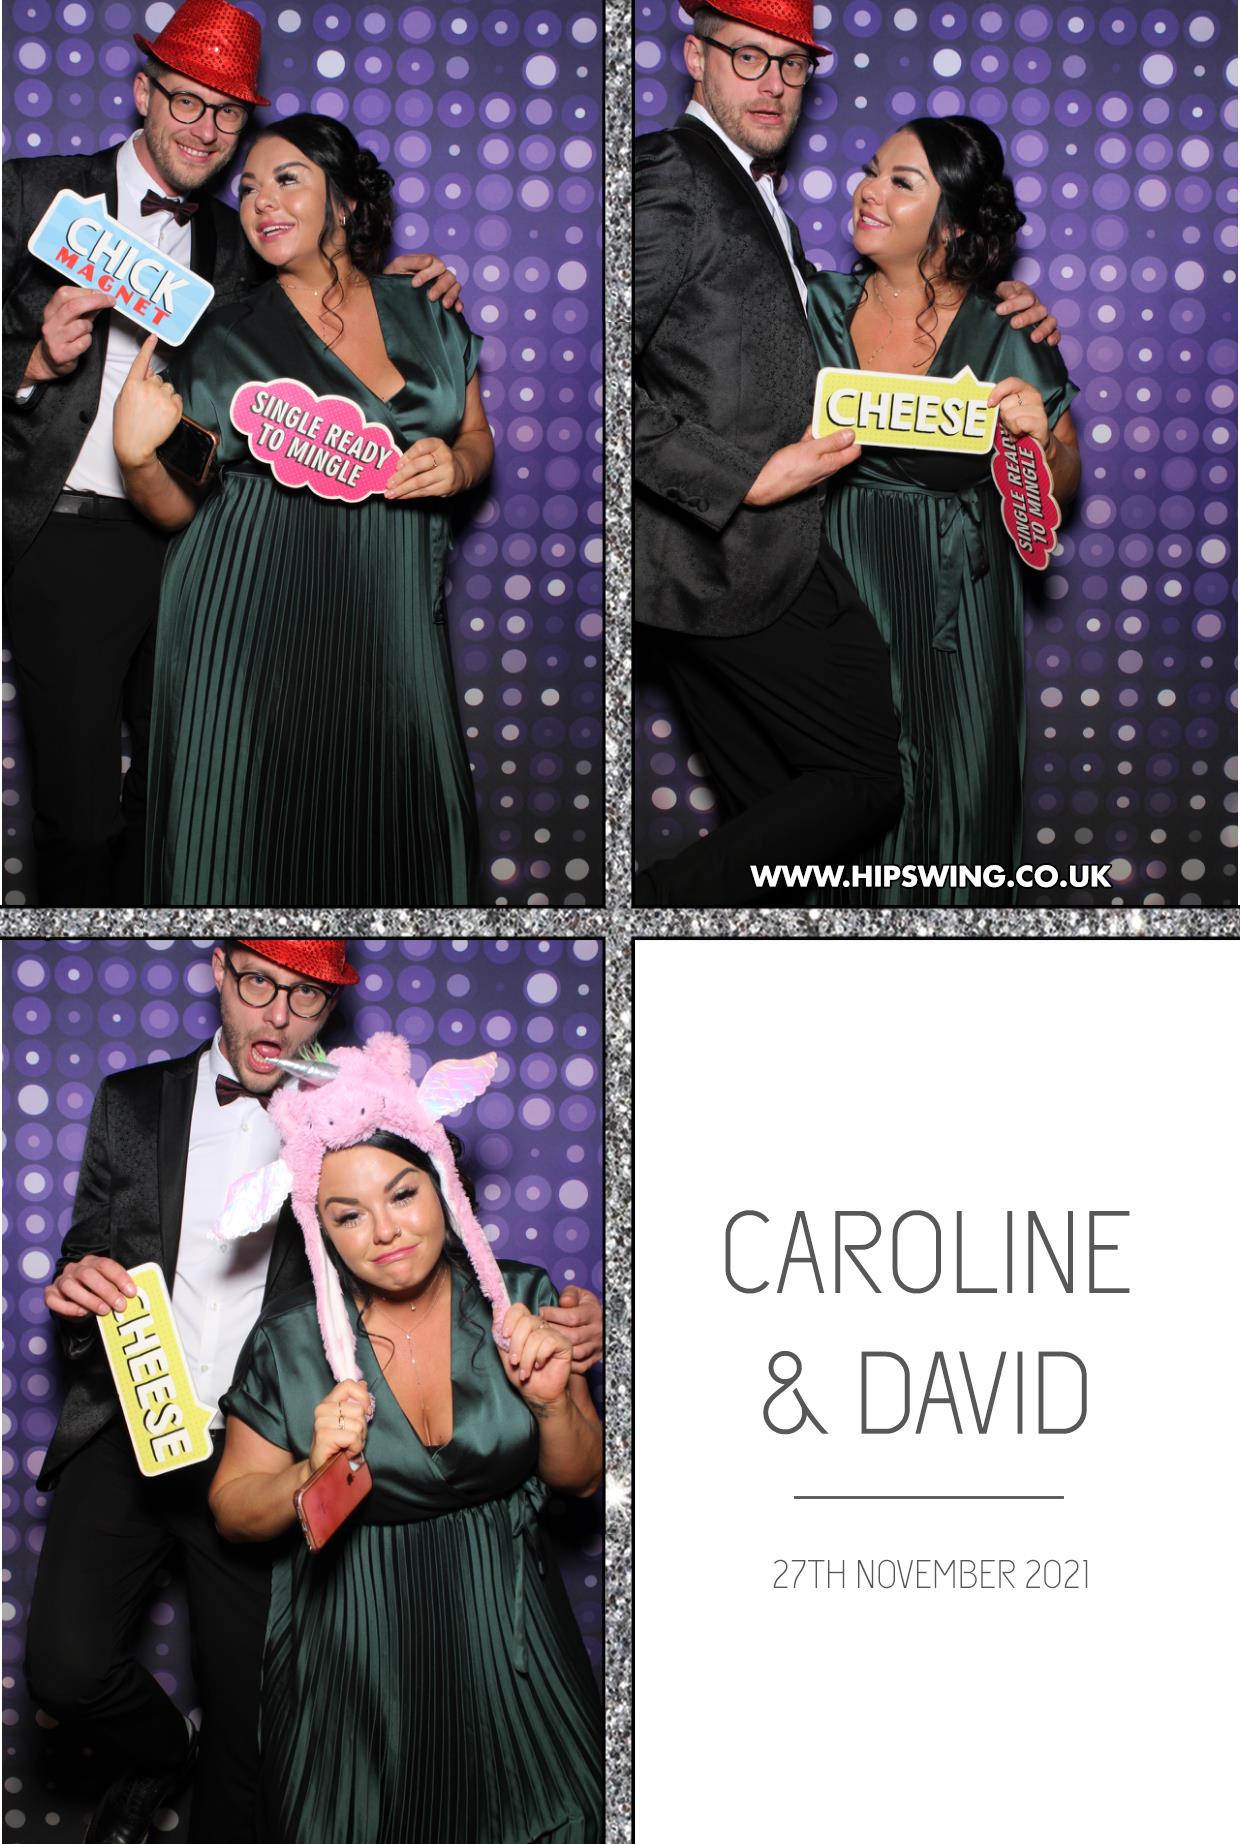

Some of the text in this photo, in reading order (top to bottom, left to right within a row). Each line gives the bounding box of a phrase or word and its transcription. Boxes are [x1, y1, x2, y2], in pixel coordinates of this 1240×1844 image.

[55, 246, 170, 325] MAGNET
[66, 217, 189, 314] CHICK
[251, 390, 393, 470] SINGLE READY
[826, 388, 988, 438] CHEESE
[256, 422, 364, 488] TO MINGLE
[1010, 489, 1034, 553] SINGLE
[1019, 446, 1048, 544] TO MINGLE
